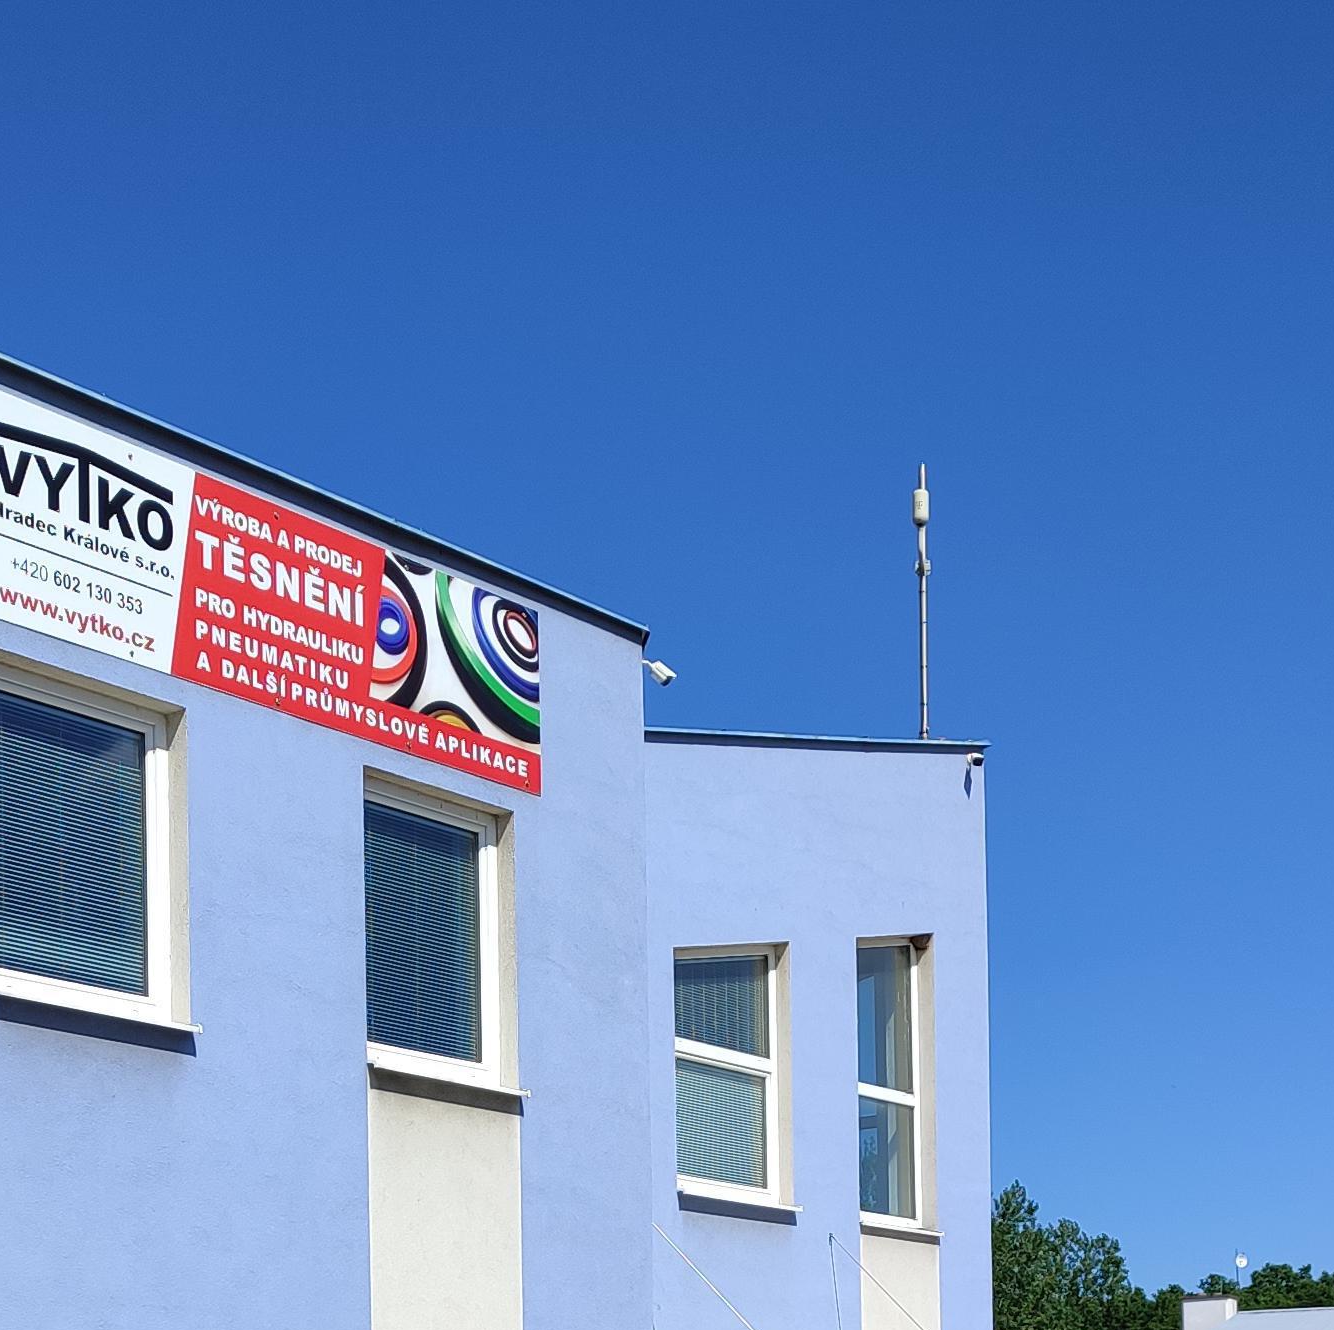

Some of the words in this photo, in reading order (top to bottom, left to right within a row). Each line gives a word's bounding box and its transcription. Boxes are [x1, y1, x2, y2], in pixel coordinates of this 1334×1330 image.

[63, 524, 130, 563] Králové
[135, 555, 175, 580] s.r.o.
[195, 494, 274, 544] VÝROBA
[277, 529, 290, 550] A
[294, 535, 362, 578] PRODEJ
[11, 557, 49, 582] +420
[53, 570, 81, 594] 602
[86, 582, 112, 604] 130
[117, 592, 143, 615] 353
[194, 530, 366, 627] TĚSNĚNÍ
[195, 587, 236, 619] PRO
[243, 605, 364, 665] HYDRAULIKU
[195, 620, 349, 690] PNEUMATIKU
[196, 651, 211, 673] A
[222, 658, 287, 697] DALŠÍ
[291, 682, 429, 746] PRŮMYSLOVÉ
[435, 732, 529, 778] APLIKACE
